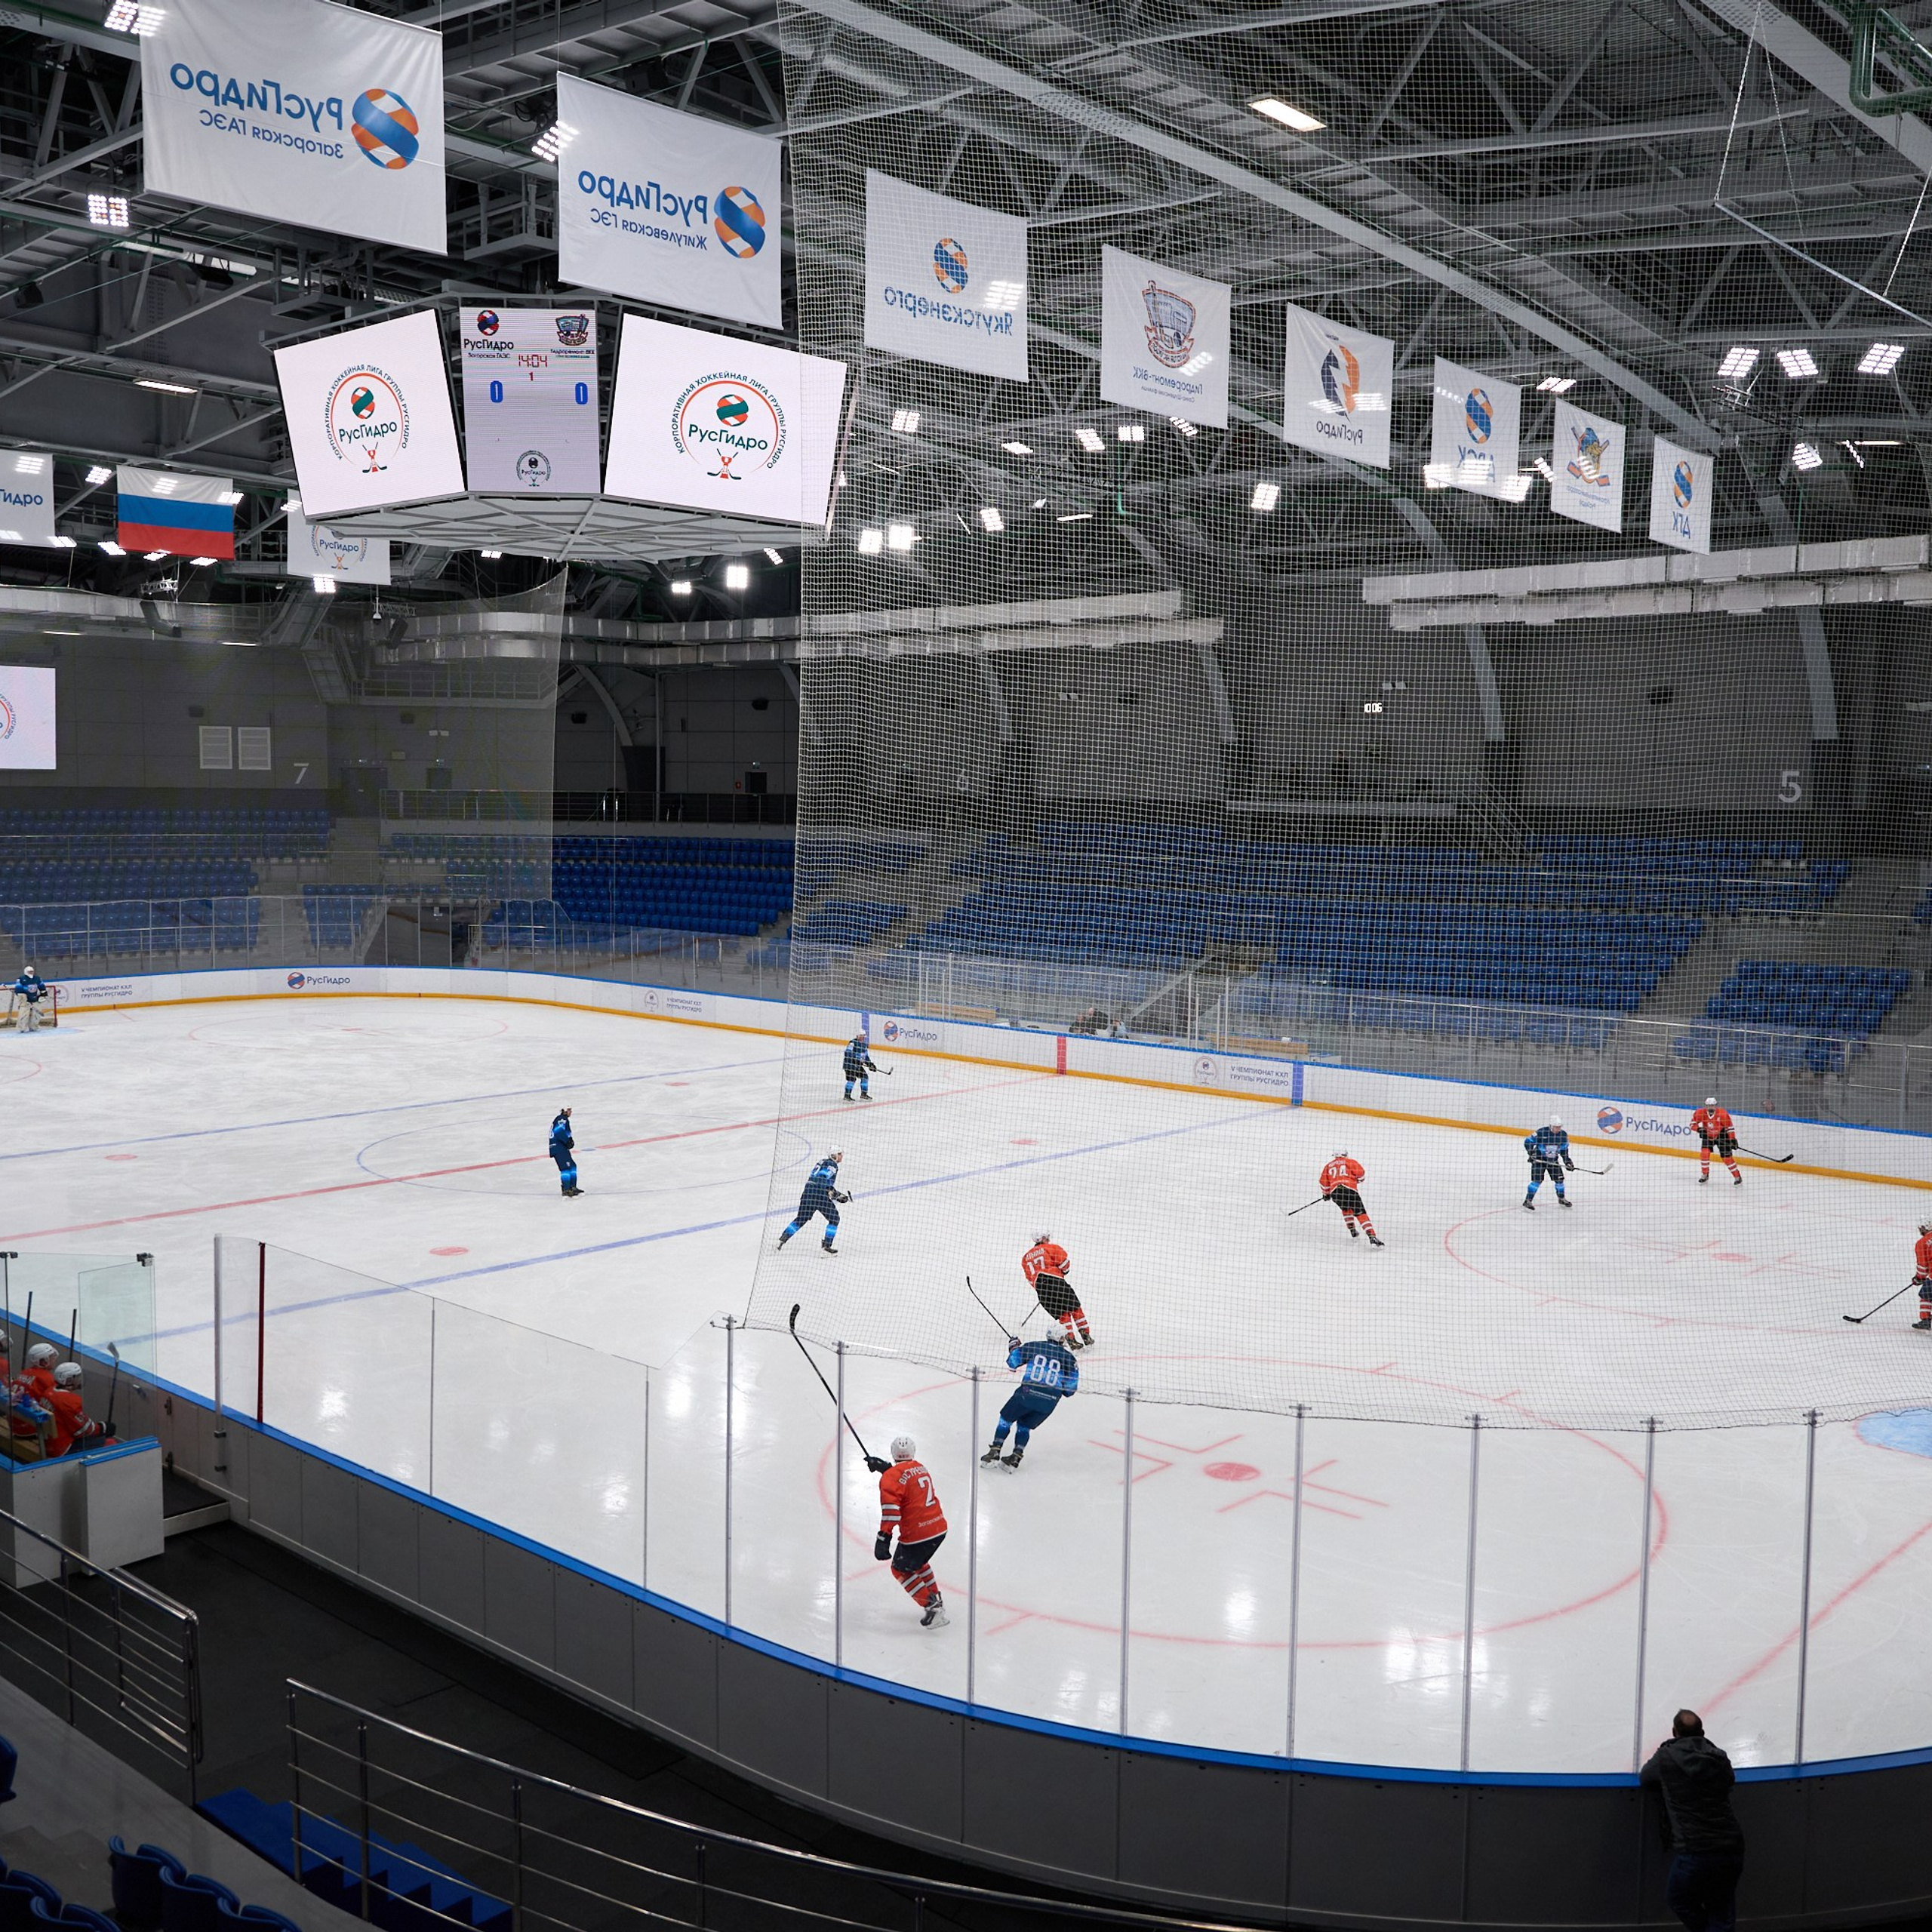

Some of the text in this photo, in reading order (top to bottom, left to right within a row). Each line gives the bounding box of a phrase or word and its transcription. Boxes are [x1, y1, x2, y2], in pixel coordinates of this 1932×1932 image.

[463, 339, 514, 351] РусГидро
[529, 372, 534, 381] 1
[491, 380, 503, 403] 0
[575, 382, 588, 405] 0
[325, 364, 410, 460] КОРПОРАТИВНАЯ ХОККЕЙНАЯ ЛИГА ГРУППЫ РУСГИДРО
[672, 371, 786, 469] КОРПОРАТИВНАЯ ХОККЕЙНАЯ ЛИГА ГРУППЫ РУСГИДРО
[339, 421, 397, 444] РусГидро
[688, 424, 768, 451] РусГидро
[319, 540, 359, 552] РусГидро
[294, 763, 309, 784] 7
[1778, 771, 1802, 804] 5
[306, 976, 351, 986] РусГидро
[900, 1028, 937, 1041] РусГидро
[1257, 1075, 1289, 1086] РУСГИДРО
[1626, 1117, 1691, 1137] РусГидро
[1027, 1256, 1045, 1275] 17
[1030, 1354, 1060, 1386] 88
